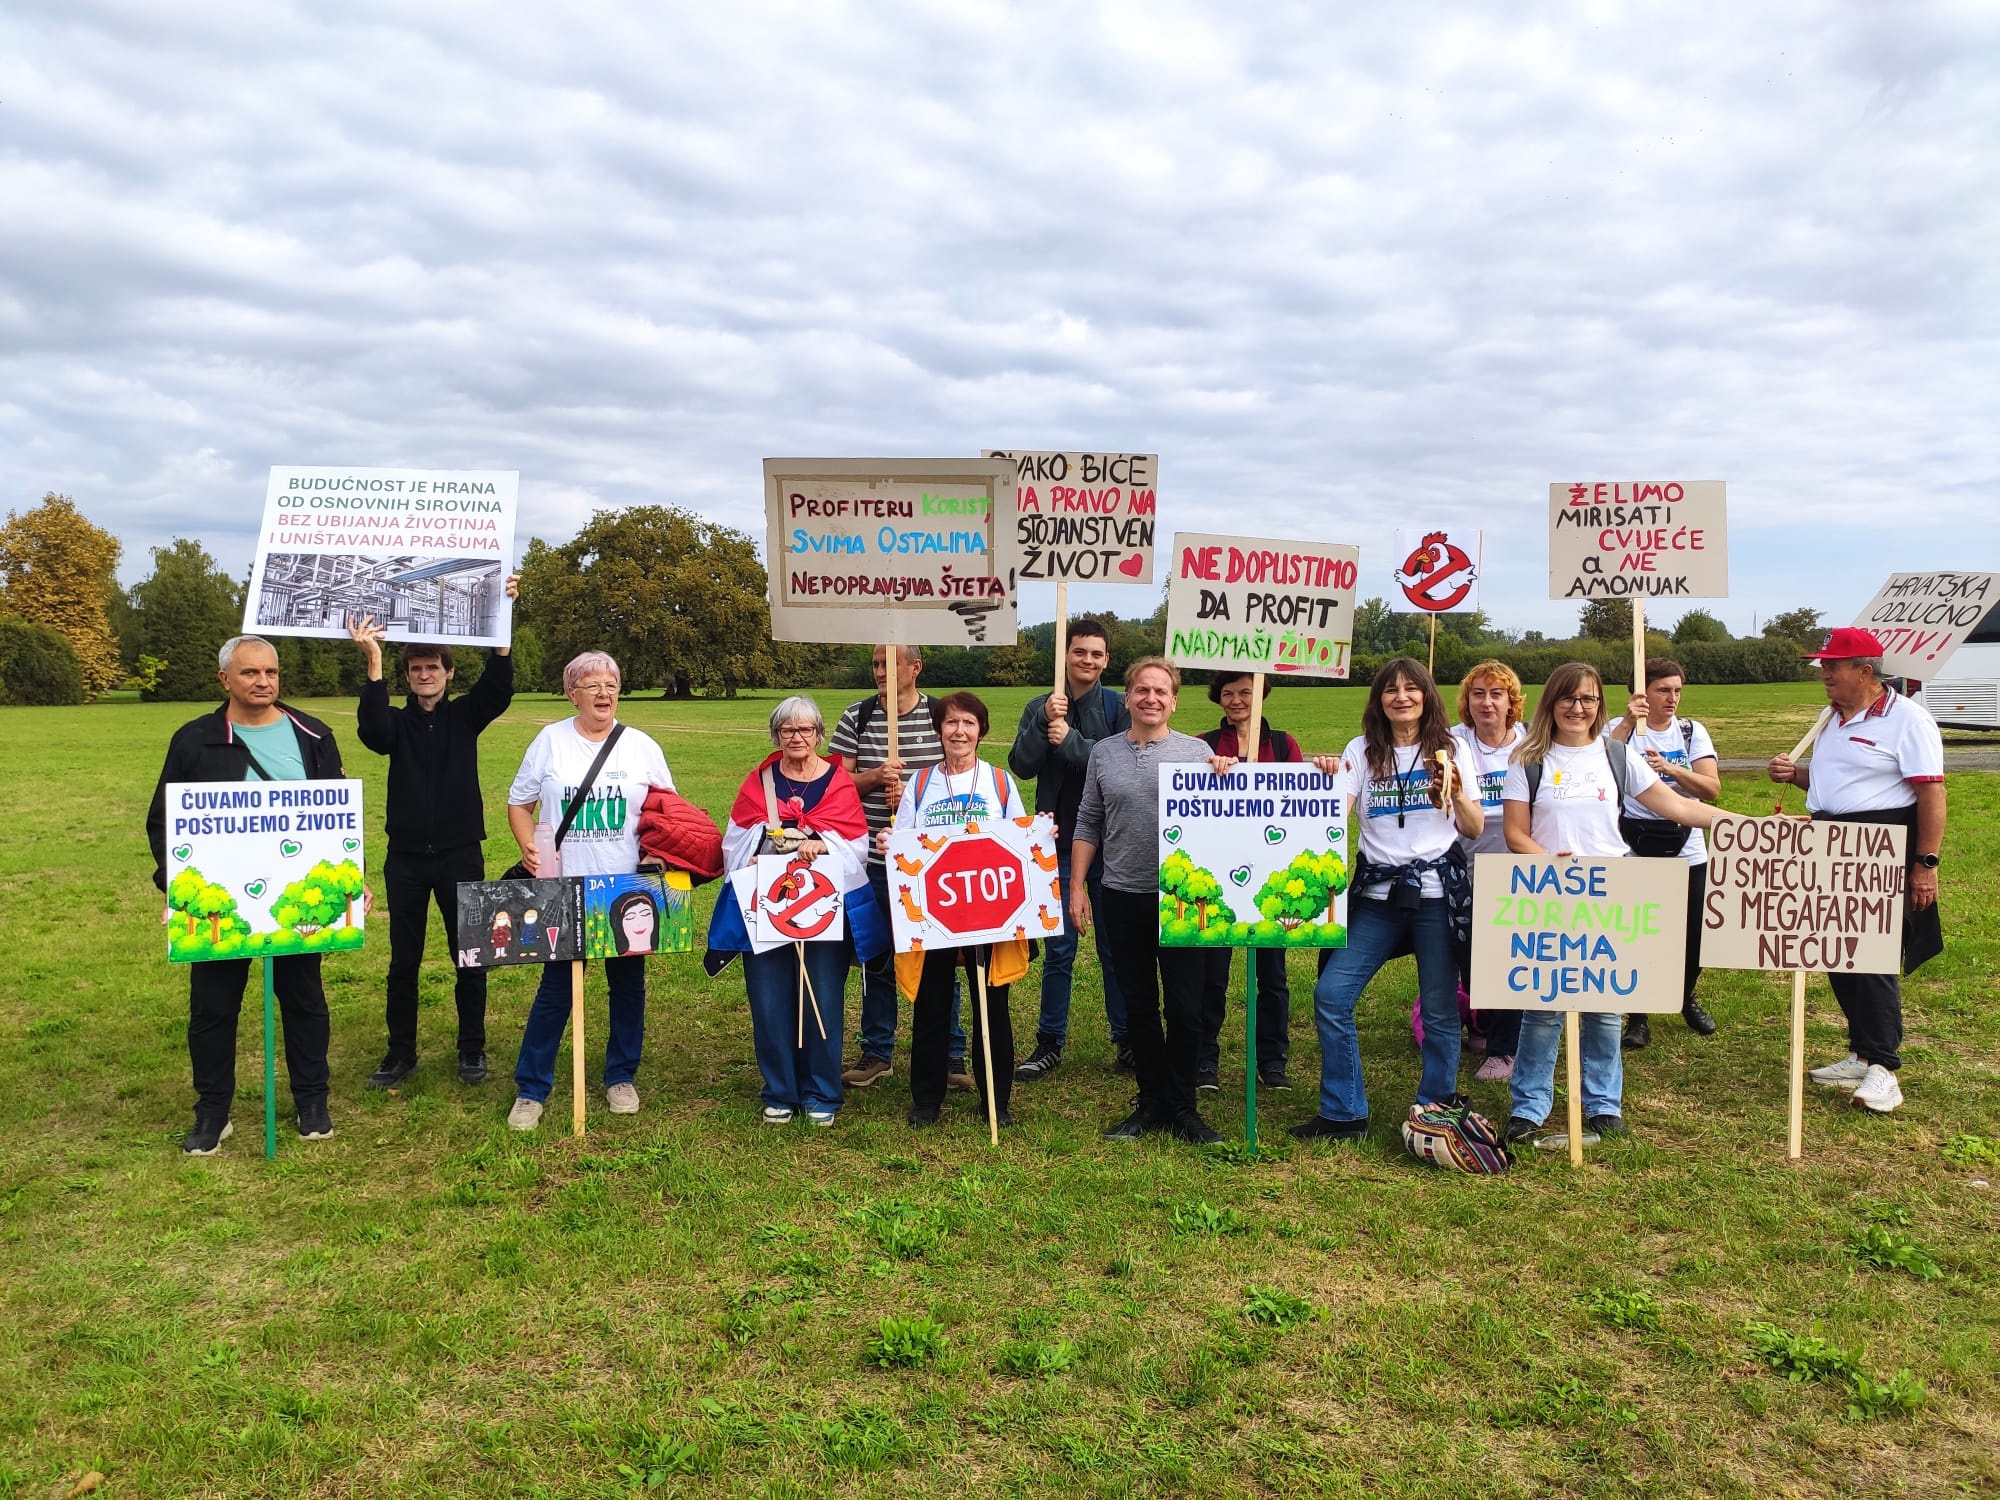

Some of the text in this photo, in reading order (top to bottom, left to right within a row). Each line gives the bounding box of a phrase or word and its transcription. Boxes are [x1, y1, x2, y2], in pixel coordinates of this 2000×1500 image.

[1081, 454, 1149, 486] BIĆE
[409, 481, 427, 493] JE
[433, 481, 496, 494] HRANA
[1050, 485, 1121, 514] PRAVO
[1127, 489, 1156, 515] NA
[1568, 482, 1684, 507] ŽELIMO
[278, 496, 502, 512] OD OSNOVNIH SIROVINA
[789, 492, 913, 519] PROFITERU
[1556, 506, 1671, 529] MIRISATI
[278, 514, 497, 531] BEZ UBIJANJA ŽIVOTINJA
[269, 531, 500, 551] I UNIŠTAVANJA PRAŠUMA
[791, 526, 986, 555] SVIMA OSTALIMA
[1598, 525, 1705, 552] CVIJEĆE
[1019, 545, 1122, 579] ŽIVOT
[1181, 546, 1357, 590] NE DOPUSTIMO
[1619, 552, 1657, 572] NE
[1565, 575, 1690, 597] AMONIJAK
[1882, 574, 1992, 601] HRVATSKA
[1197, 589, 1338, 628] DA PROFIT
[1871, 598, 1982, 627] ODLUČNO
[1171, 627, 1274, 662] NADMAŠI
[1172, 769, 1334, 791] ČUVAMO PRIRODU
[181, 788, 349, 810] ČUVAMO PRIRODU
[1166, 795, 1341, 817] POŠTUJEMO ŽIVOTE
[175, 811, 356, 836] POŠTUJEMO ŽIVOTE
[1712, 819, 1896, 858] GOSPIĆ PLIVA
[938, 866, 1017, 907] STOP
[1511, 858, 1607, 896] NAŠE
[1709, 856, 1727, 886] U
[1735, 857, 1823, 894] SMEĆU,
[1492, 898, 1662, 943] ZDRAVLJE
[1705, 890, 1892, 934] S MEGAFARMI
[459, 947, 482, 968] NE
[1511, 932, 1617, 961] NEMA
[1758, 933, 1859, 969] NEĆU!
[1508, 966, 1638, 1002] CIJENU
